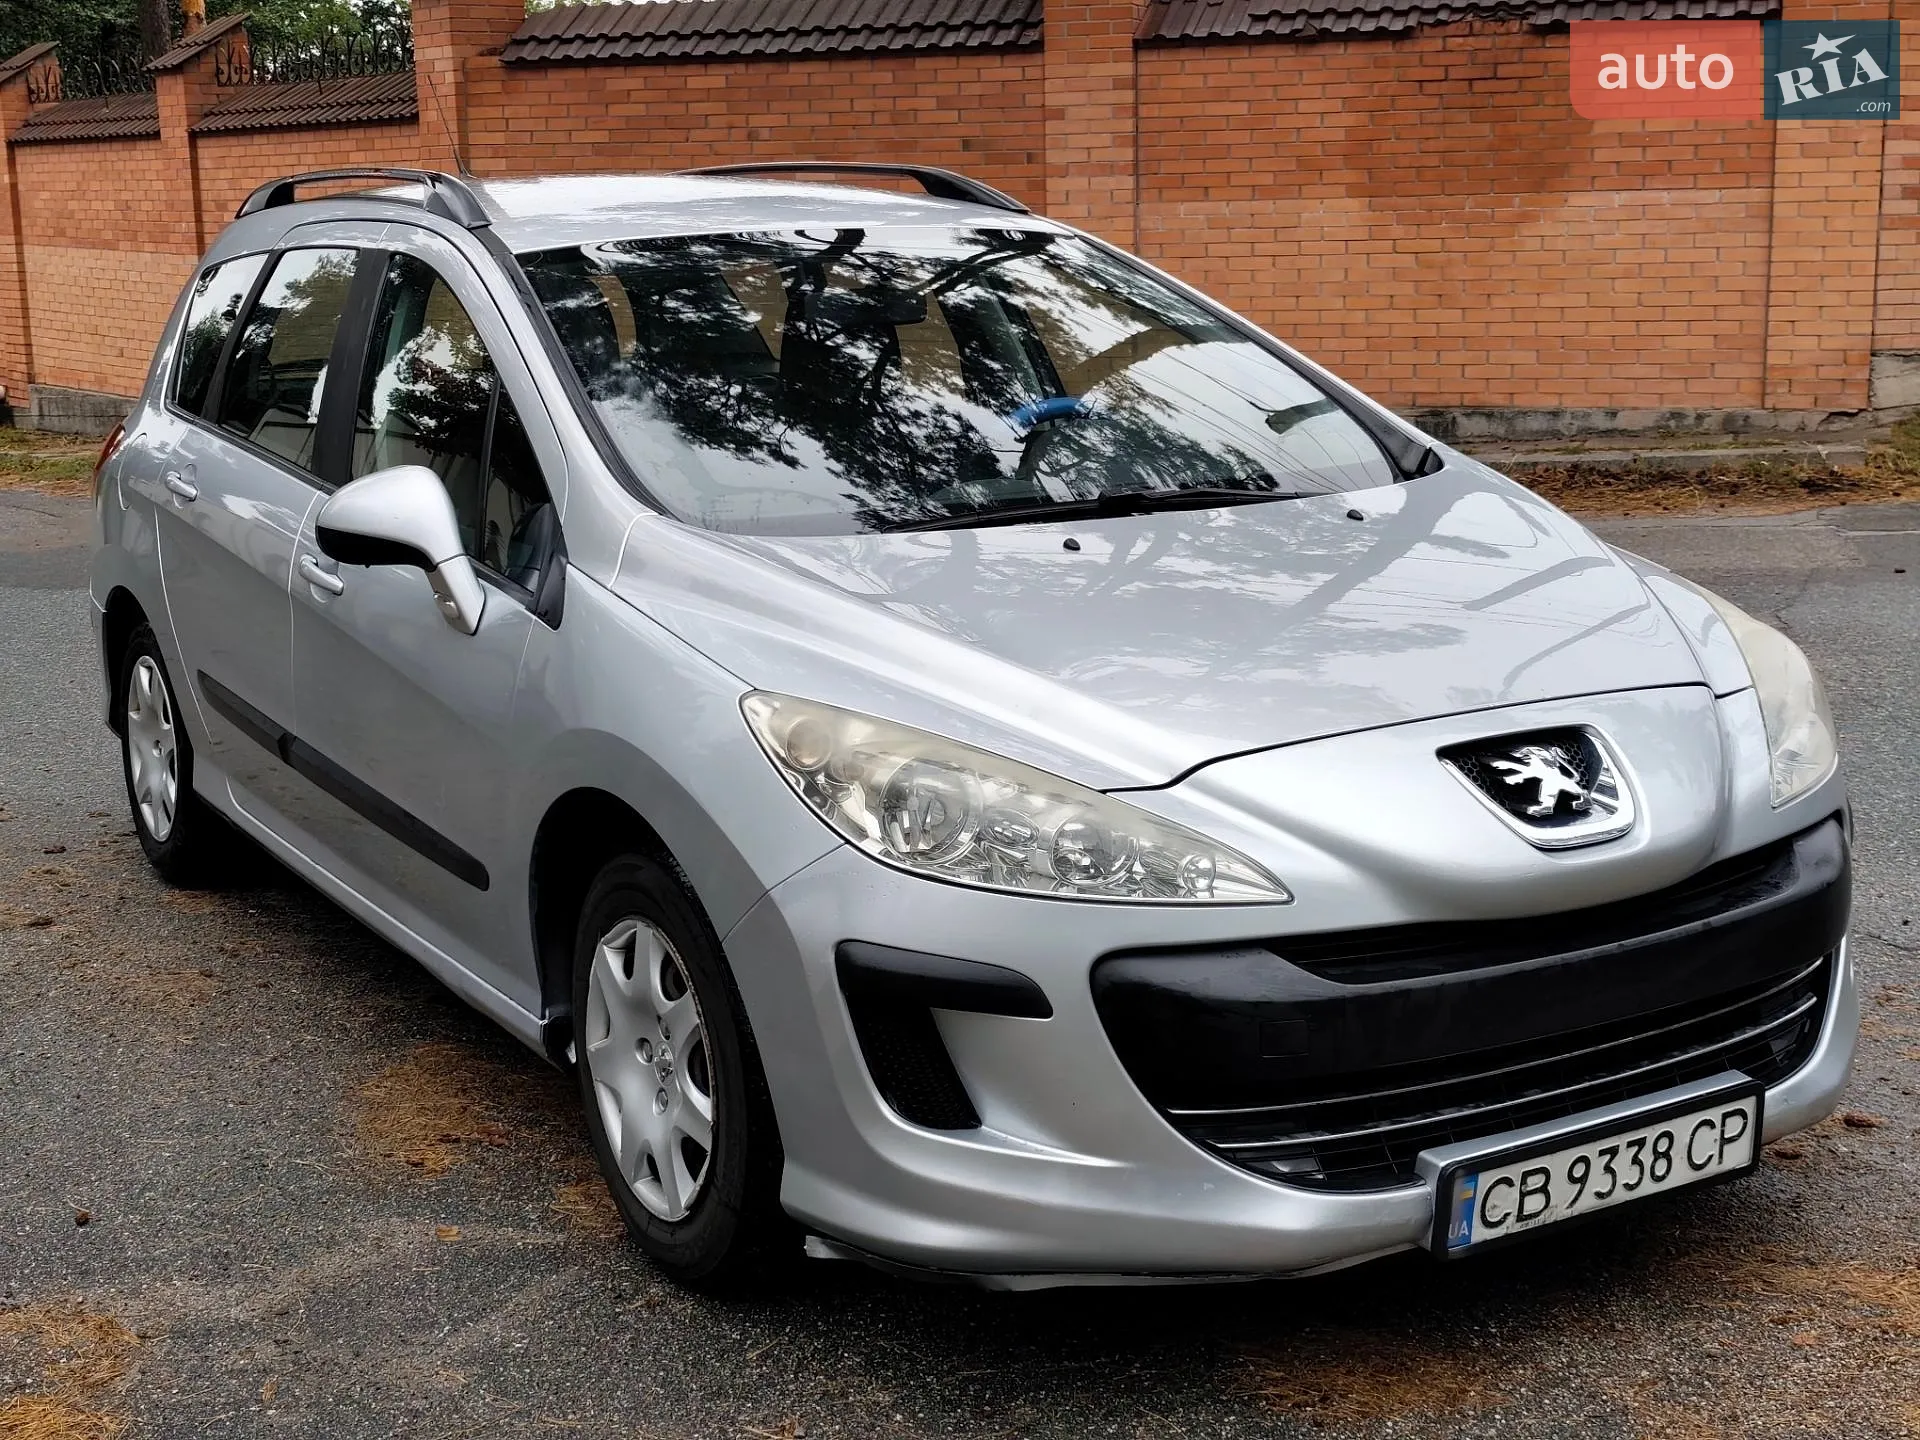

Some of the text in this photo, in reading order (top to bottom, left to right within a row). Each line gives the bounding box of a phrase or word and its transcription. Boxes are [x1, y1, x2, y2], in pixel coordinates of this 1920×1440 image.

[1480, 1107, 1748, 1229] CB 9338 CP
[1448, 1220, 1469, 1239] UA
